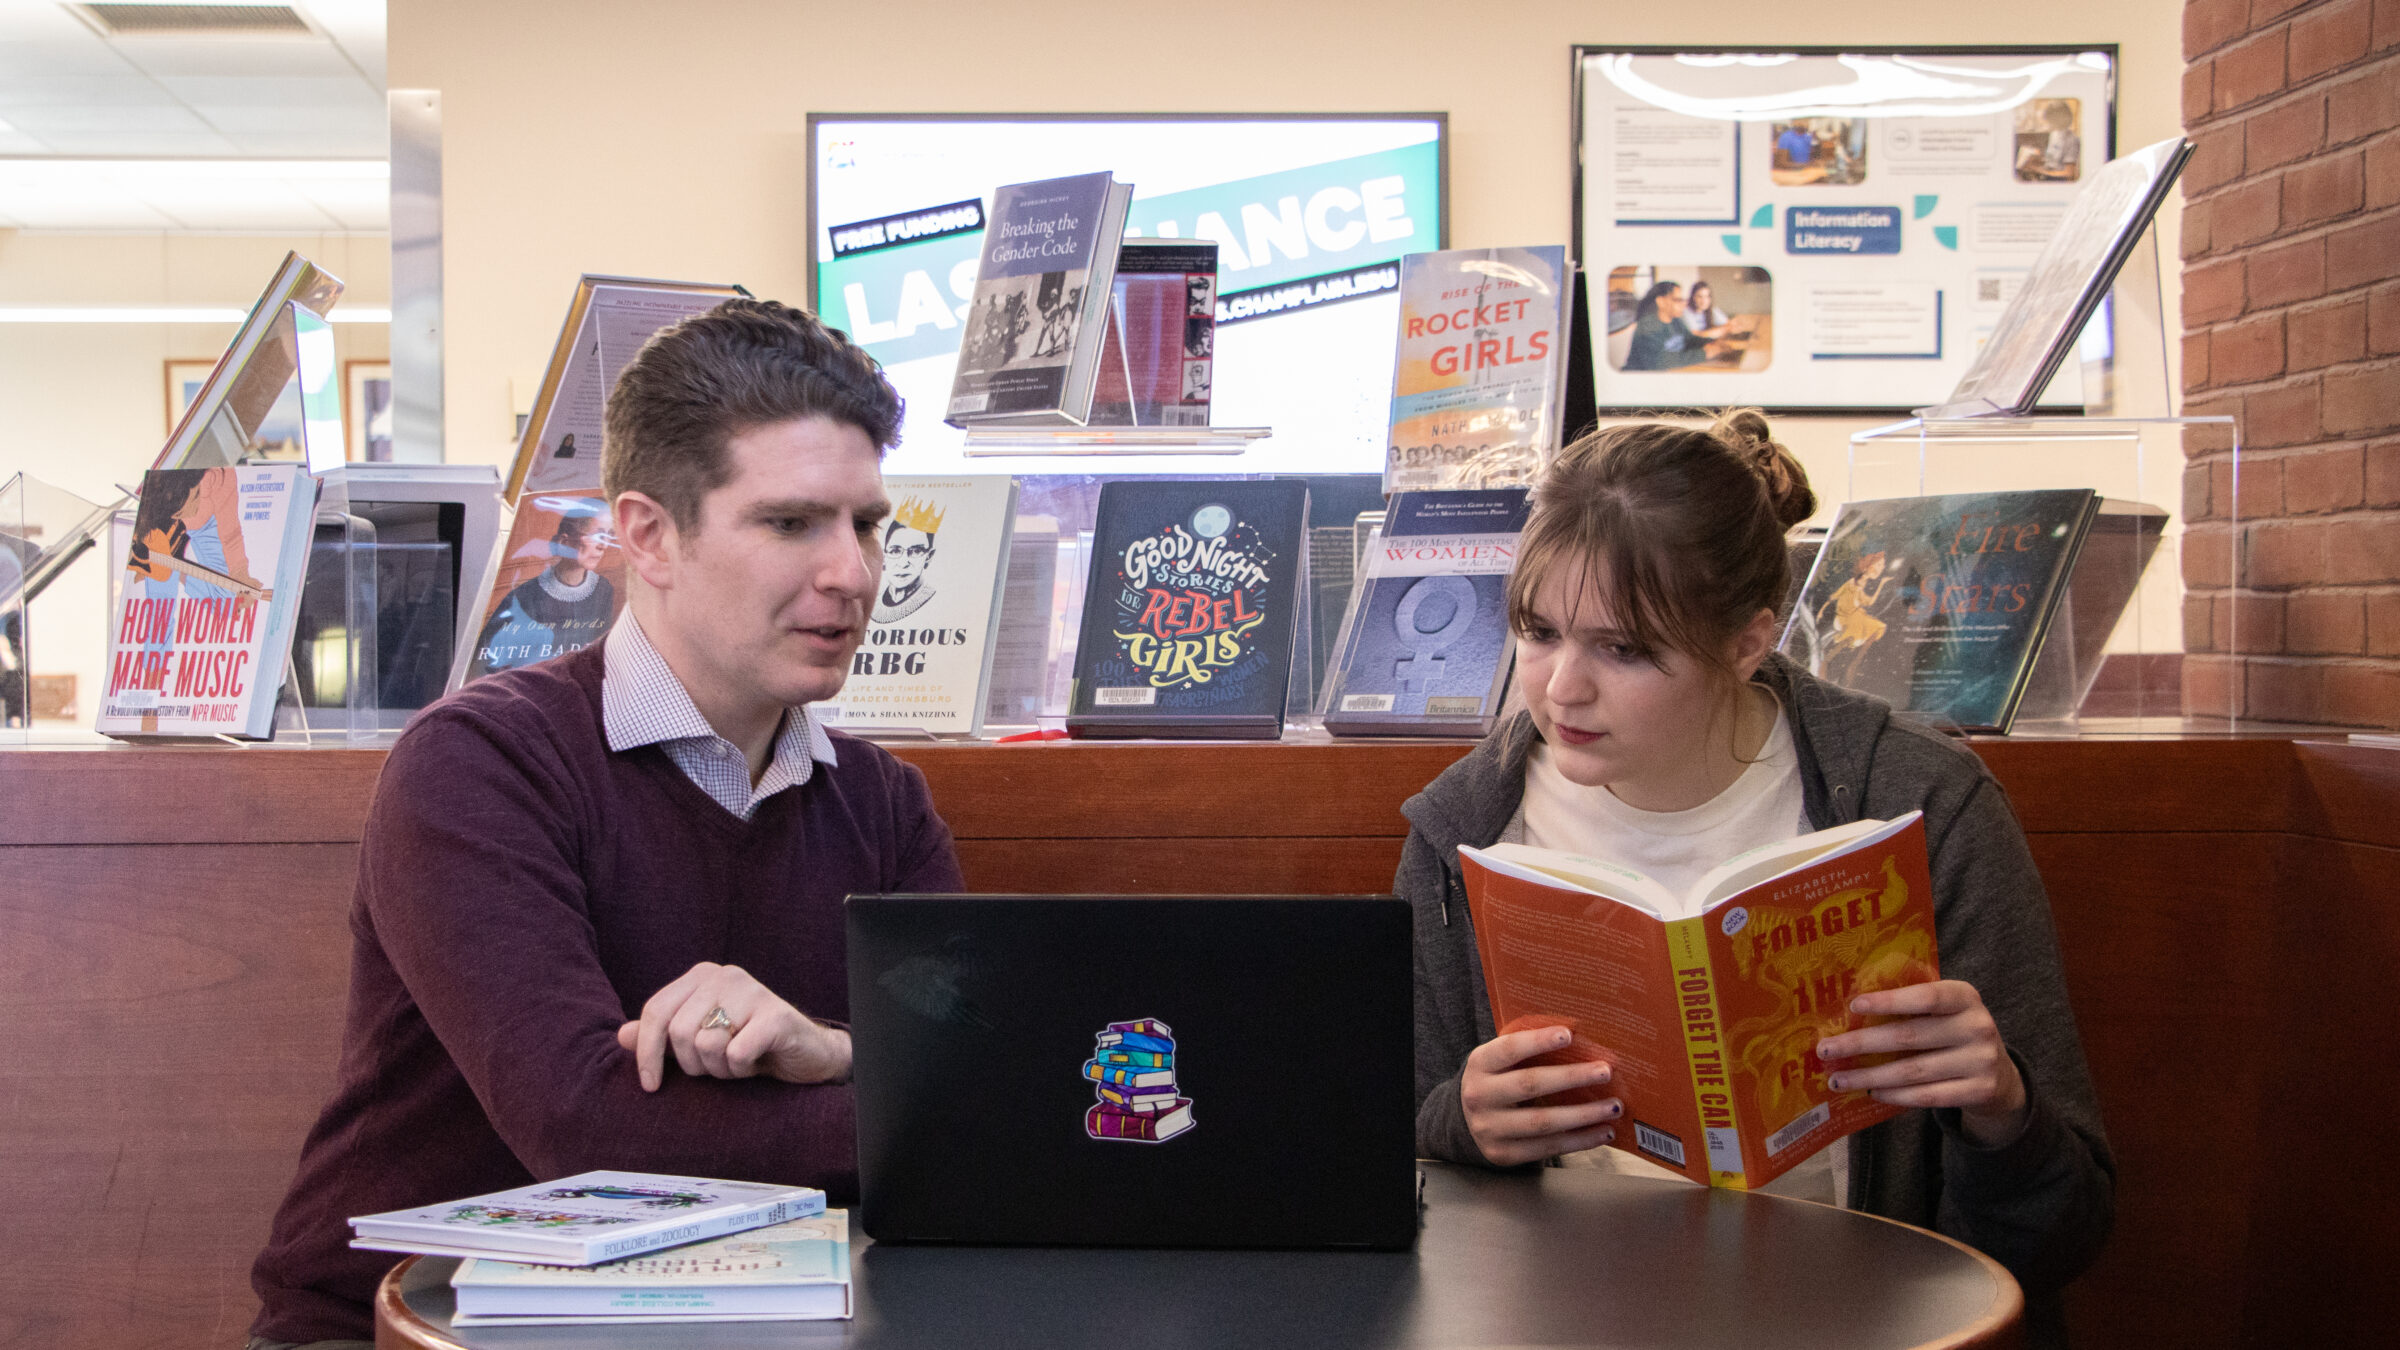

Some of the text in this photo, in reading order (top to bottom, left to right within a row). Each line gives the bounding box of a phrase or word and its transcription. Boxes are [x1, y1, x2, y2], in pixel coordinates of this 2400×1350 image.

[834, 205, 981, 253] FREE FUNDING
[1001, 213, 1079, 239] Breaking the
[1124, 175, 1415, 271] ANCE
[1795, 210, 1891, 228] Information
[992, 236, 1078, 263] Gender Code
[1795, 233, 1863, 252] Literacy
[843, 258, 979, 346] LAS
[1441, 281, 1521, 301] RISE OF THE
[1407, 298, 1531, 340] ROCKET
[1430, 331, 1550, 377] GIRLS
[1410, 539, 1426, 548] 100
[1945, 512, 2041, 557] Fire
[1125, 524, 1194, 589] GOOD
[1177, 536, 1270, 590] NIGHT
[1386, 545, 1514, 561] WOMEN
[1155, 563, 1236, 594] STORIES
[1120, 588, 1142, 610] FOR
[1907, 573, 2031, 616] Stars
[119, 598, 175, 644] HOW
[175, 597, 259, 644] WOMEN
[502, 618, 606, 635] My Own Words
[1138, 588, 1259, 640] REBEL
[478, 645, 531, 661] RUTH
[851, 651, 927, 676] RBG
[1113, 613, 1265, 687] GIRLS
[108, 650, 249, 698] MADE MUSIC
[852, 685, 871, 693] LIFE
[875, 685, 895, 693] AND
[898, 685, 927, 693] TIMES
[175, 705, 191, 717] FROM
[190, 704, 209, 722] NPR
[210, 703, 239, 722] MUSIC
[852, 695, 894, 704] BADER
[894, 695, 953, 704] GINSBURG
[1429, 704, 1476, 714] Britannica
[1773, 869, 1847, 901] ELIZABETH
[1805, 871, 1871, 902] MELAMPY
[1725, 910, 1743, 927] NEW
[1726, 914, 1748, 934] BOOK
[1752, 889, 1885, 966] FORGET
[1682, 925, 1693, 960] MELAMPY
[1678, 967, 1718, 1044] FORGET
[1692, 1050, 1725, 1087] THE
[728, 1215, 745, 1227] FLOE
[746, 1211, 760, 1224] FOX
[604, 1224, 701, 1257] FOLKLORE and ZOOLOGY
